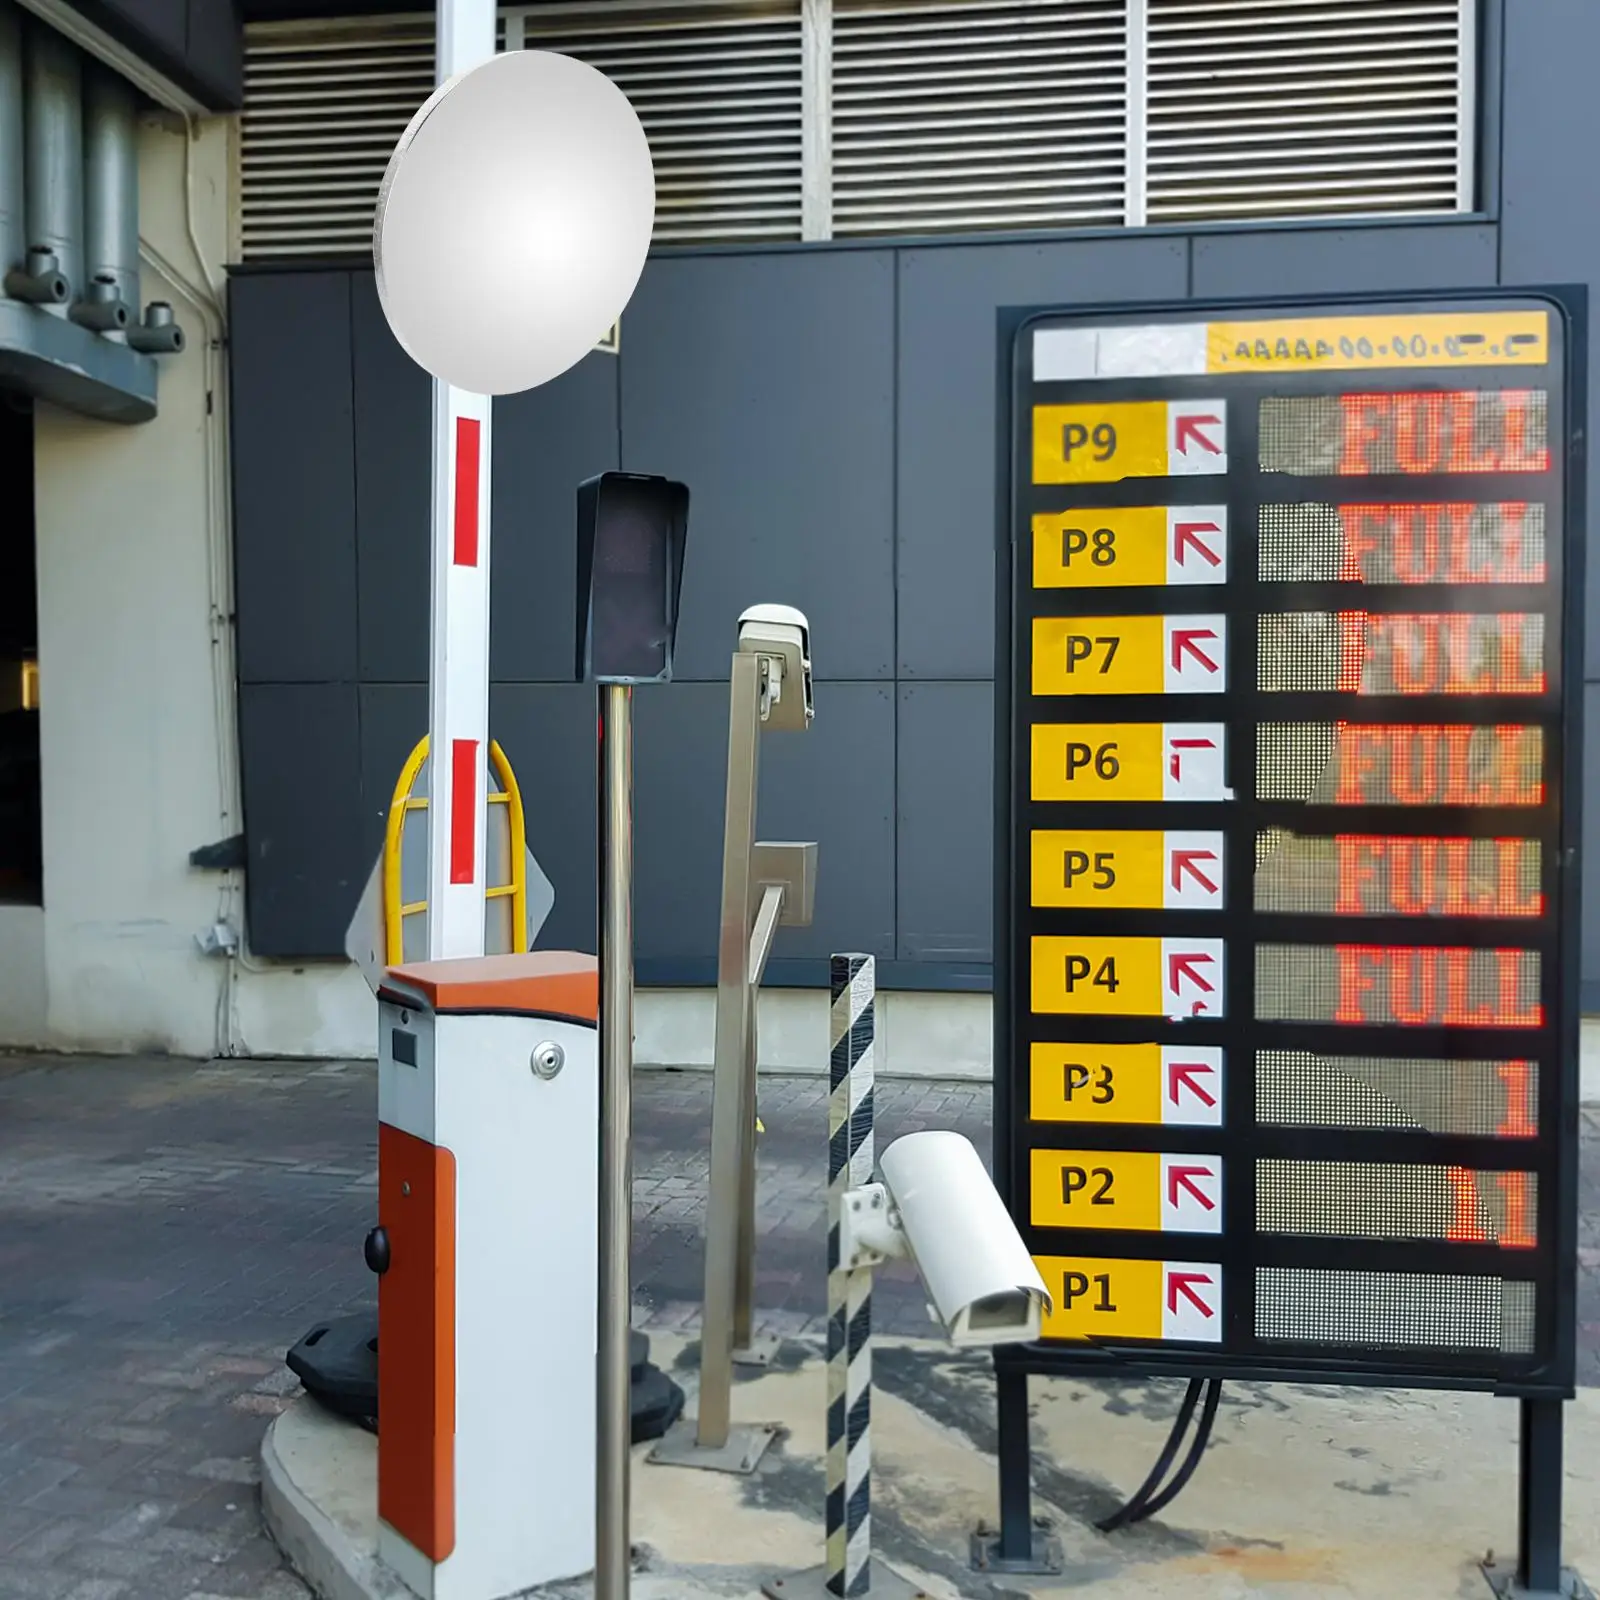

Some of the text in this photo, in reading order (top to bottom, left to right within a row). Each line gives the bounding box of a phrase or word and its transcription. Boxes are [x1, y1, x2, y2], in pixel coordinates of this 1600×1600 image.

[1063, 423, 1117, 462] P9
[1340, 391, 1550, 475] FULL
[1062, 528, 1116, 567] P8
[1338, 501, 1547, 583] FULL
[1066, 635, 1120, 674] P7
[1338, 610, 1547, 695] FULL
[1066, 742, 1120, 781] P6
[1336, 721, 1545, 805] FULL
[1063, 850, 1116, 890] P5
[1335, 835, 1544, 916] FULL
[1065, 955, 1120, 993] P4
[1335, 945, 1543, 1027] FULL
[1063, 1063, 1115, 1104] P3
[1061, 1166, 1115, 1205] P2
[1448, 1168, 1536, 1247] 11
[1063, 1271, 1117, 1313] P1
